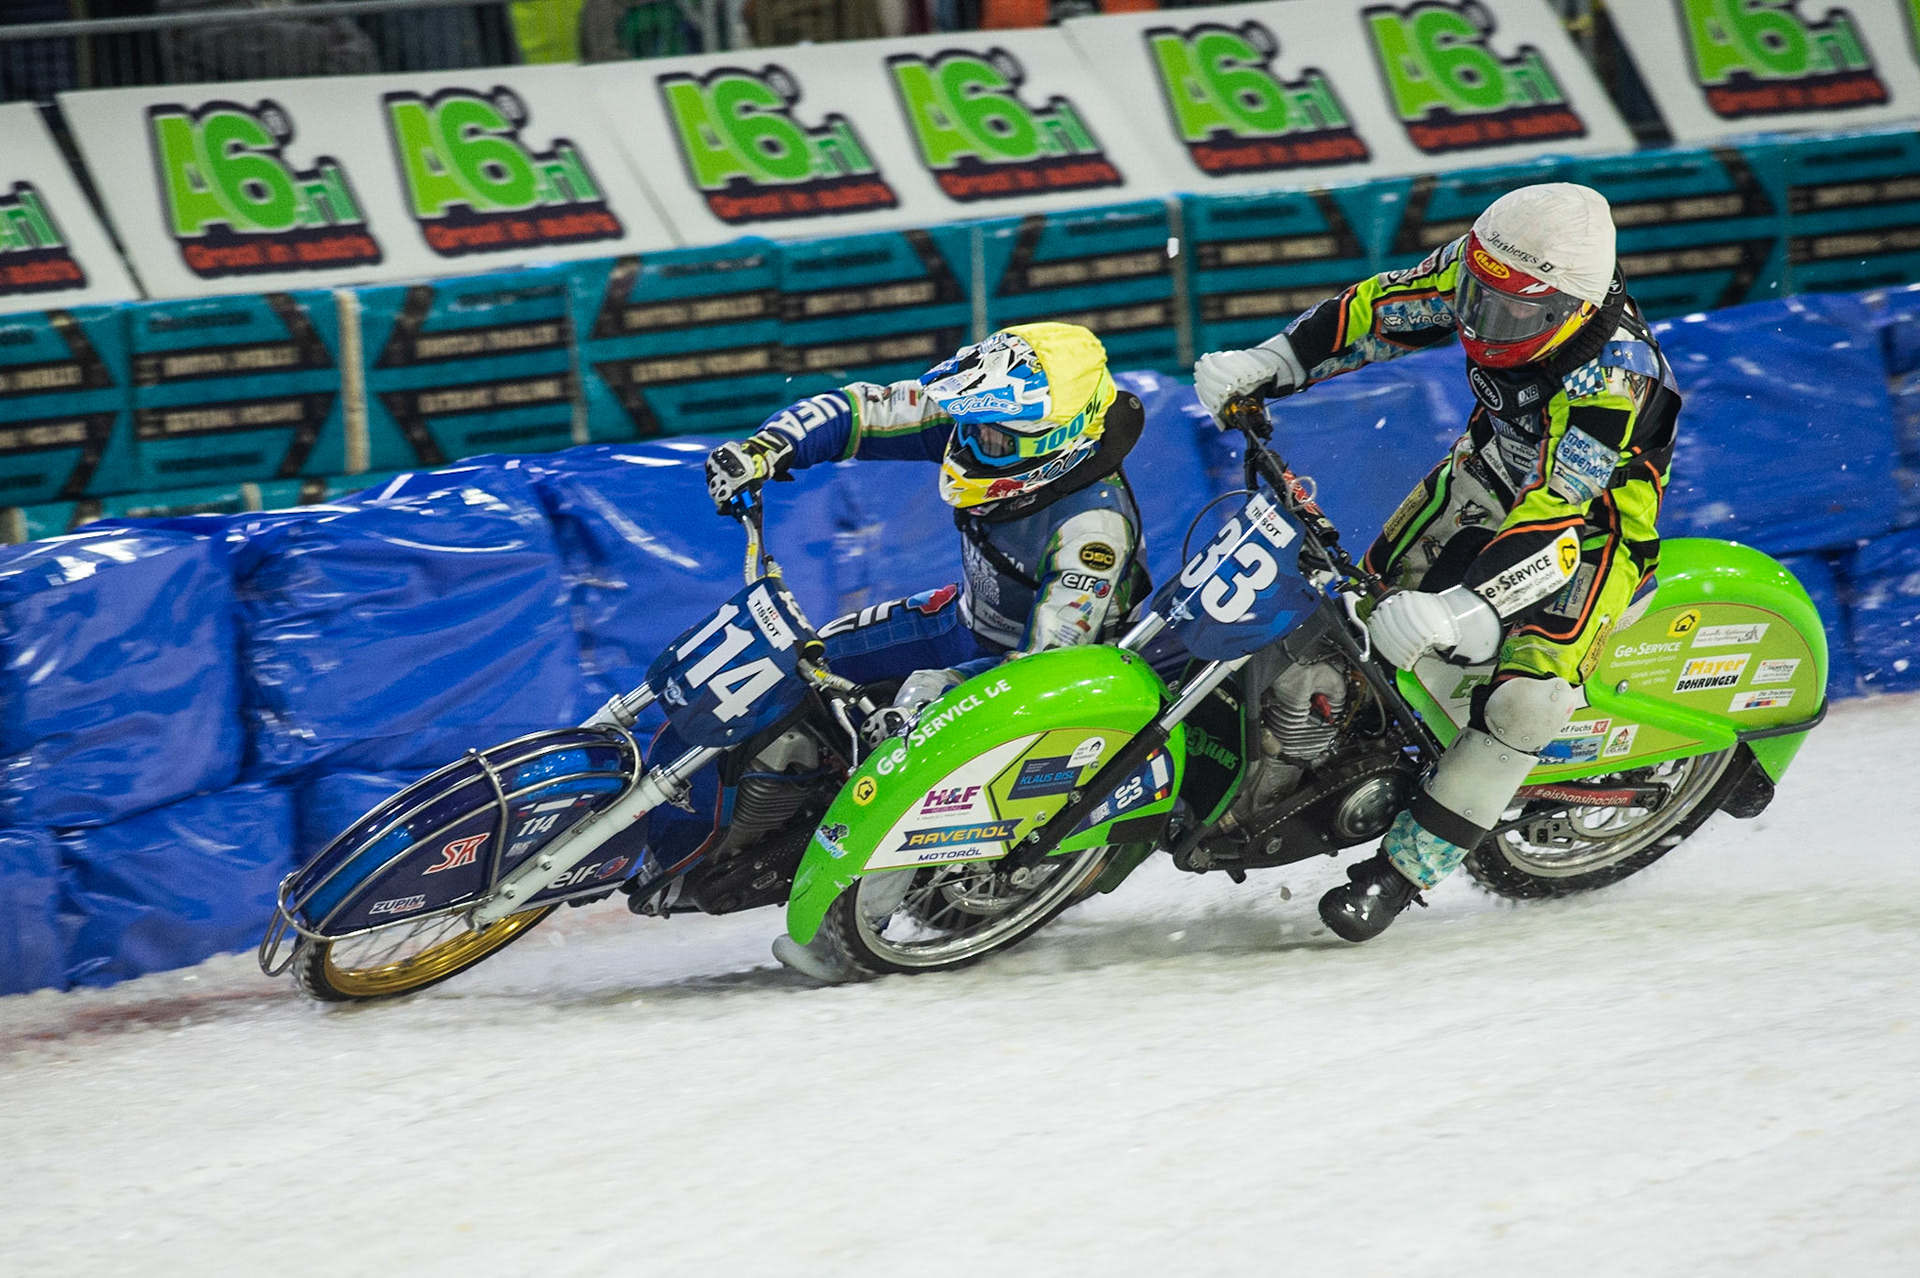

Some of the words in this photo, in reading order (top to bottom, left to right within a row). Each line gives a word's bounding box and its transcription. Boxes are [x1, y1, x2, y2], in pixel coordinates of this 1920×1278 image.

[1473, 374, 1499, 407] ORTEMA
[1033, 393, 1101, 455] 100%
[1566, 431, 1590, 453] msc
[1061, 573, 1095, 592] elf
[1180, 517, 1278, 623] 33
[752, 599, 782, 637] TISSOT
[676, 603, 786, 723] 114
[1689, 659, 1746, 676] Mayer
[1676, 674, 1739, 691] BOHRUNGEN
[909, 694, 984, 748] SERVICE
[1019, 772, 1054, 785] KLAUS
[923, 785, 982, 808] H&F
[1114, 775, 1143, 810] 33
[517, 813, 560, 838] 114
[909, 825, 1008, 846] RAVENOL
[917, 848, 983, 862] MOTORÖL
[547, 862, 602, 890] elf
